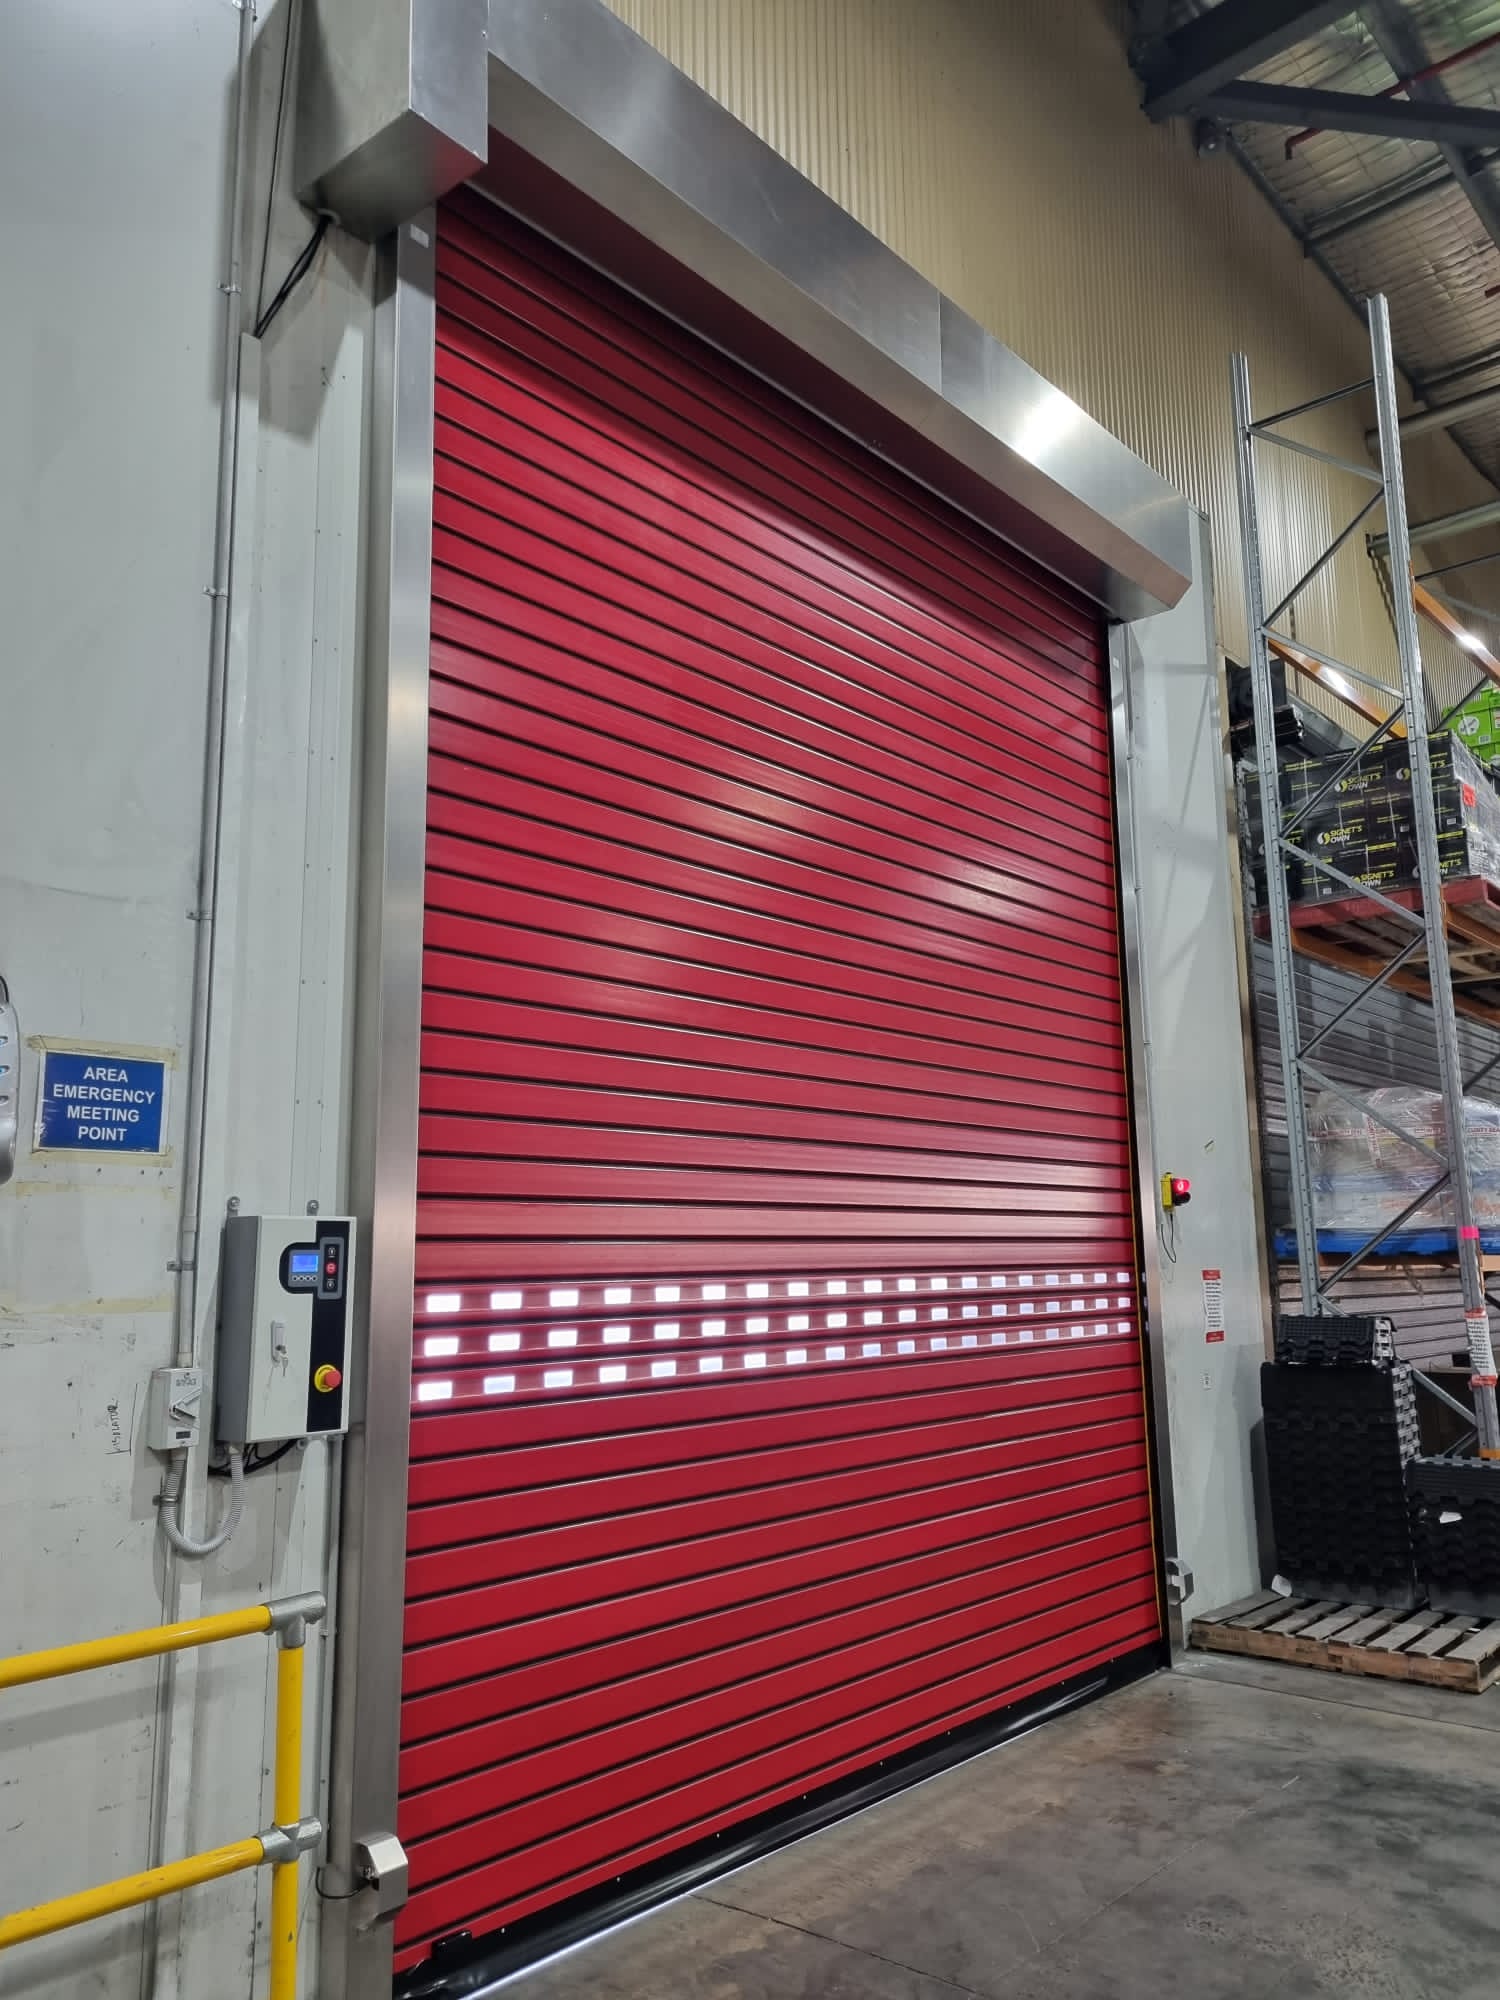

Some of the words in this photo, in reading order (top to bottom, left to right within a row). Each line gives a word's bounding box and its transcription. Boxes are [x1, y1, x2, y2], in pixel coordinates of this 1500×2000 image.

[1330, 825, 1363, 837] SIGNET'S
[1330, 834, 1351, 844] OWN
[83, 1066, 128, 1082] AREA
[53, 1083, 156, 1104] EMERGENCY
[67, 1104, 140, 1122] MEETING
[78, 1125, 128, 1141] POINT
